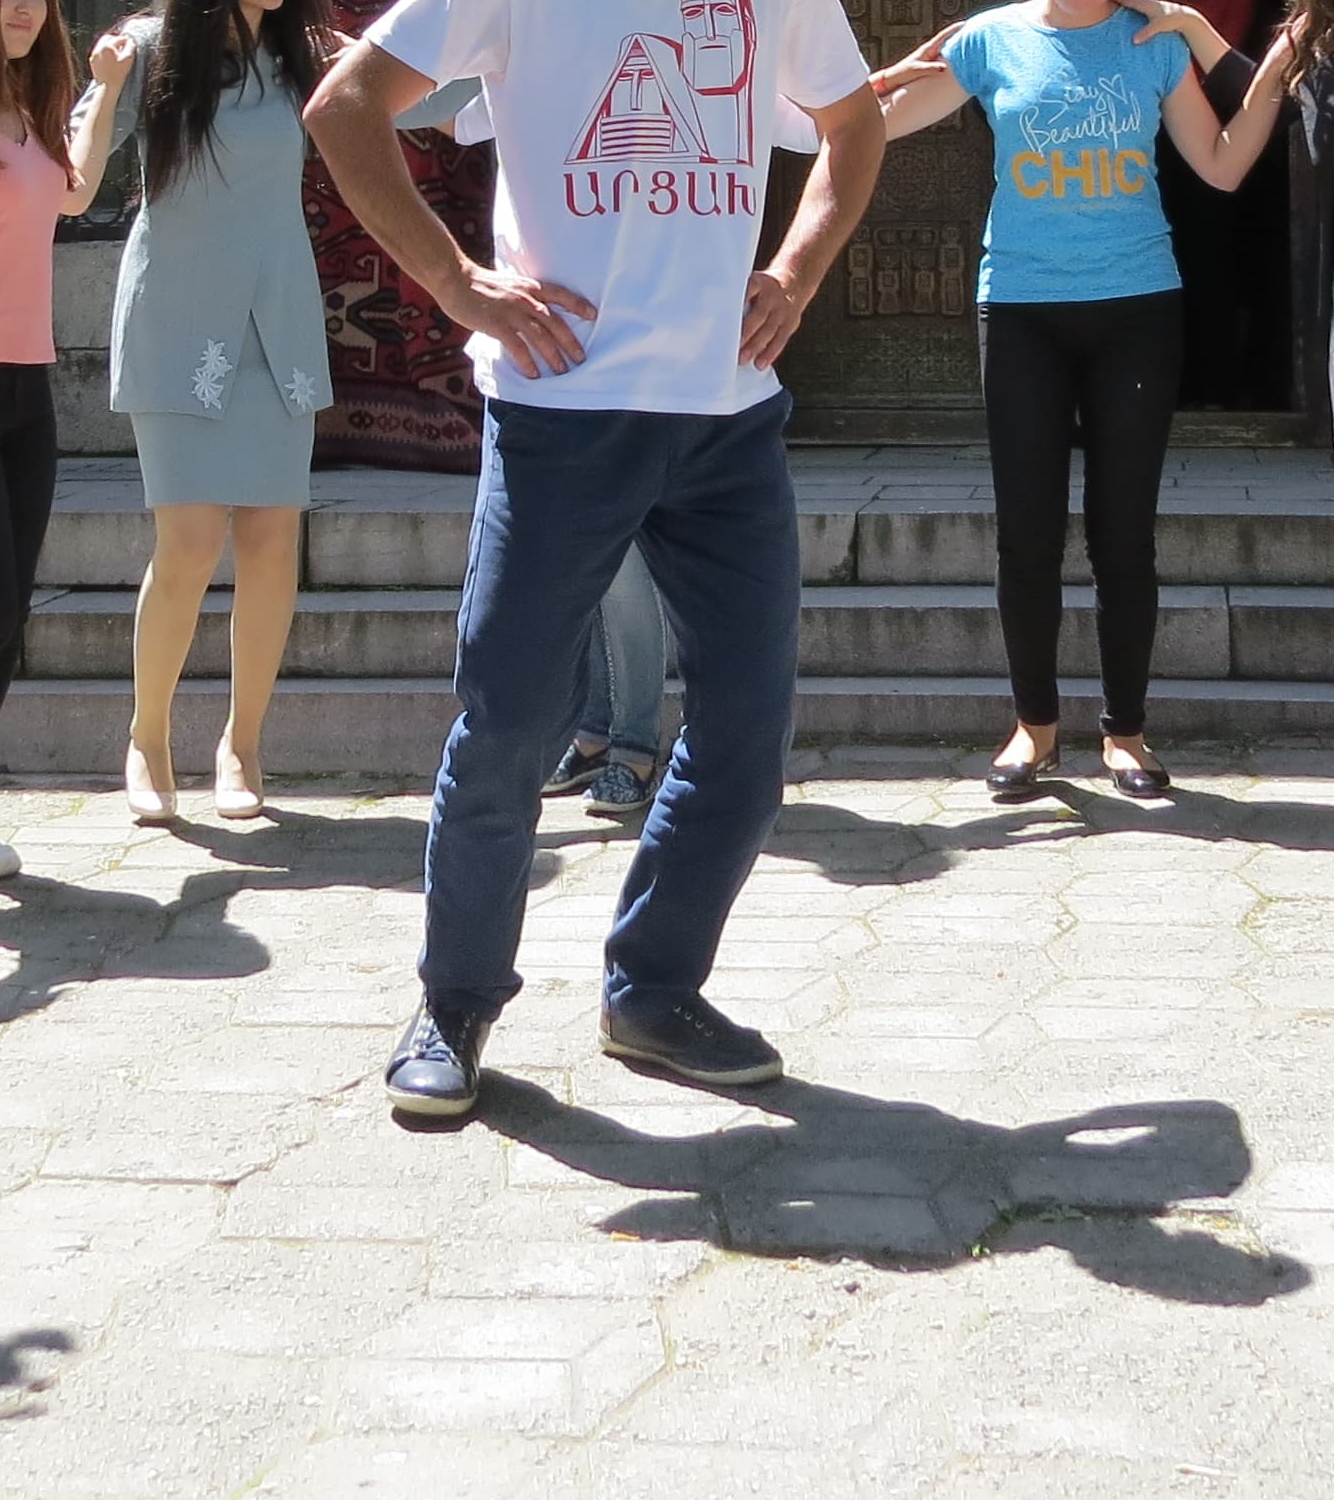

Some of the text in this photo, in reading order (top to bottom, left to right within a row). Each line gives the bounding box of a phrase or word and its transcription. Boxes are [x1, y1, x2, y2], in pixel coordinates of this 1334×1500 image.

[1038, 71, 1107, 124] Stay
[1019, 92, 1141, 158] Beautiful
[563, 169, 757, 217] ԱՐՑԱԽ
[1011, 149, 1149, 199] CHIC
